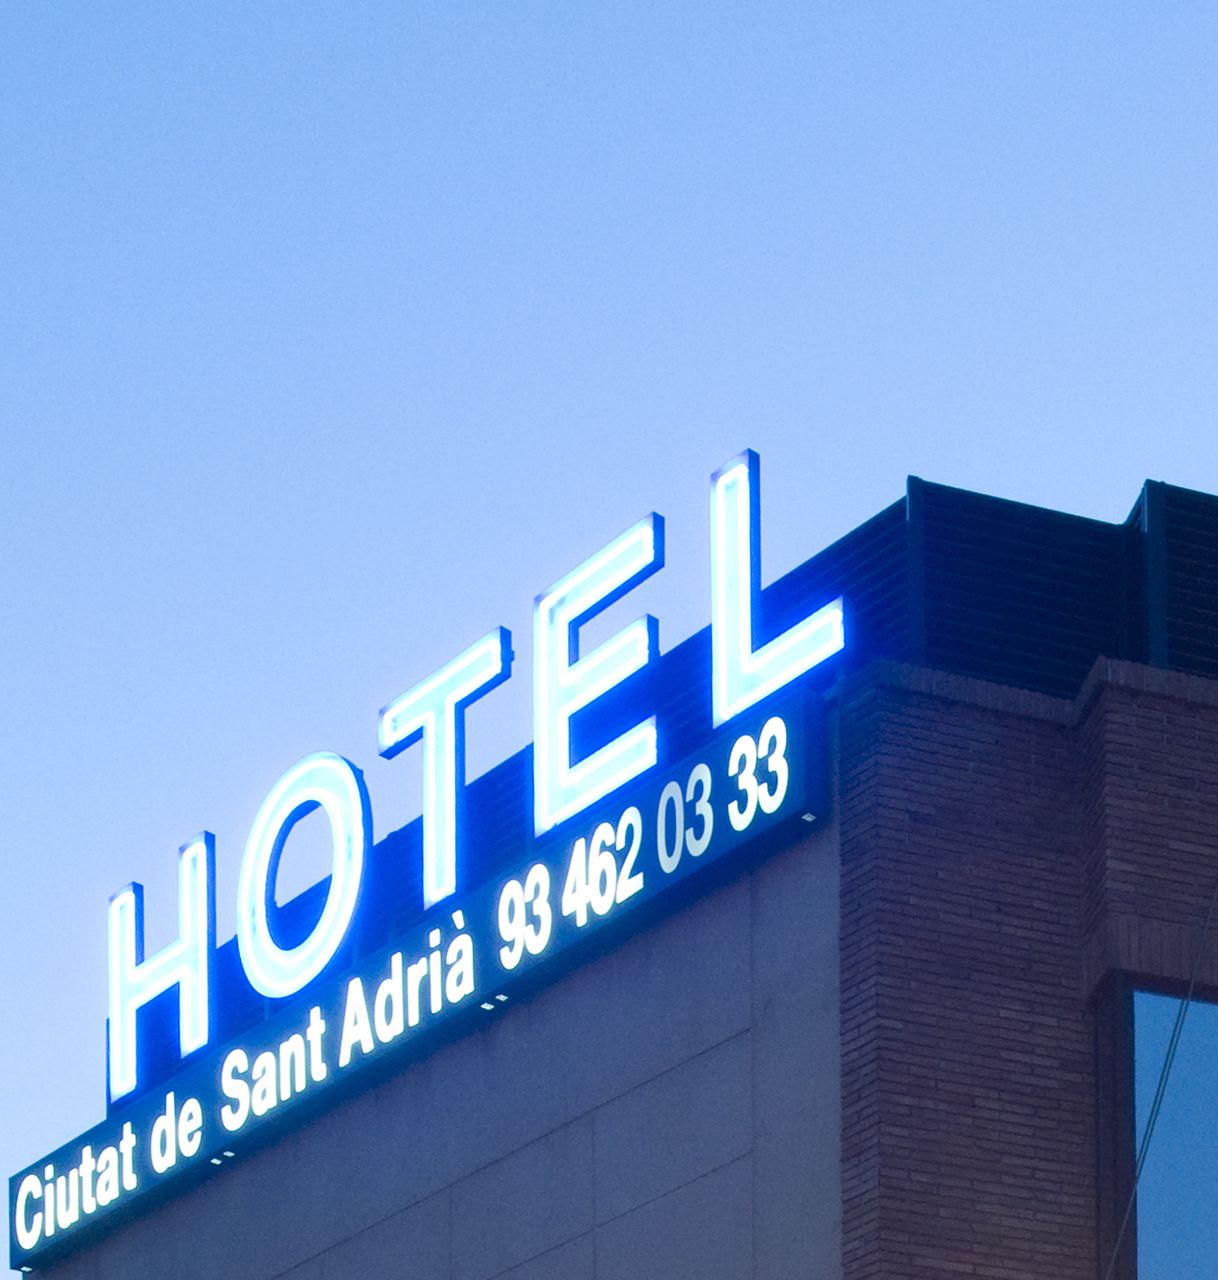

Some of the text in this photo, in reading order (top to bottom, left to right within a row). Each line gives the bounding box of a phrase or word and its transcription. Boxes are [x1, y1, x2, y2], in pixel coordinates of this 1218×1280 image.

[15, 716, 790, 1250] Ciutat de Sant Adrià 93 462 03 33
[108, 448, 844, 1103] HOTEL
